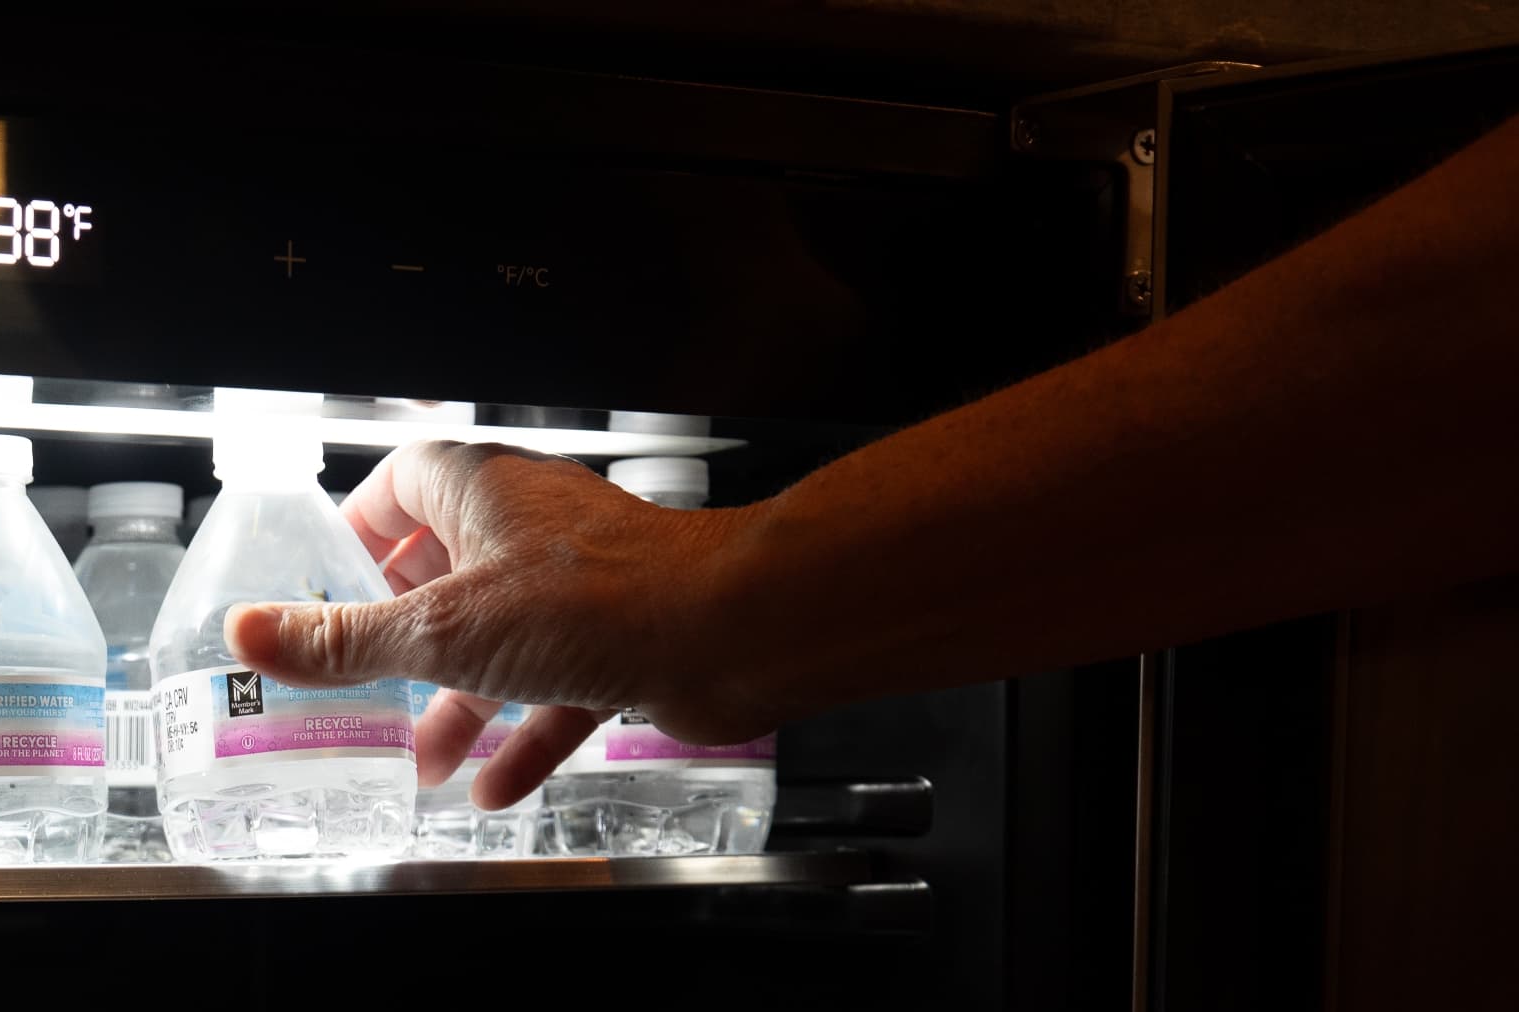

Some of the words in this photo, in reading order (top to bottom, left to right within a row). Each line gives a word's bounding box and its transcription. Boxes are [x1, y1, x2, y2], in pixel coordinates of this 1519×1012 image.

[164, 691, 173, 711] CA
[173, 686, 188, 708] CRV
[290, 690, 310, 700] FOR
[312, 690, 340, 699] YOUR
[342, 689, 371, 698] THIRST
[39, 696, 74, 707] WATER
[231, 700, 261, 710] Member's
[10, 708, 36, 718] YOUR
[37, 708, 67, 718] THIRST
[238, 707, 254, 715] Mark
[190, 721, 198, 735] 5¢
[305, 717, 362, 731] RECYCLE
[293, 732, 314, 741] FOR
[315, 731, 336, 740] THE
[337, 730, 371, 739] PLANET
[383, 728, 388, 741] 8
[389, 728, 399, 742] FL
[2, 736, 57, 748] RECYCLE
[12, 749, 31, 758] THE
[32, 749, 65, 758] PLANET
[78, 747, 85, 761] FL
